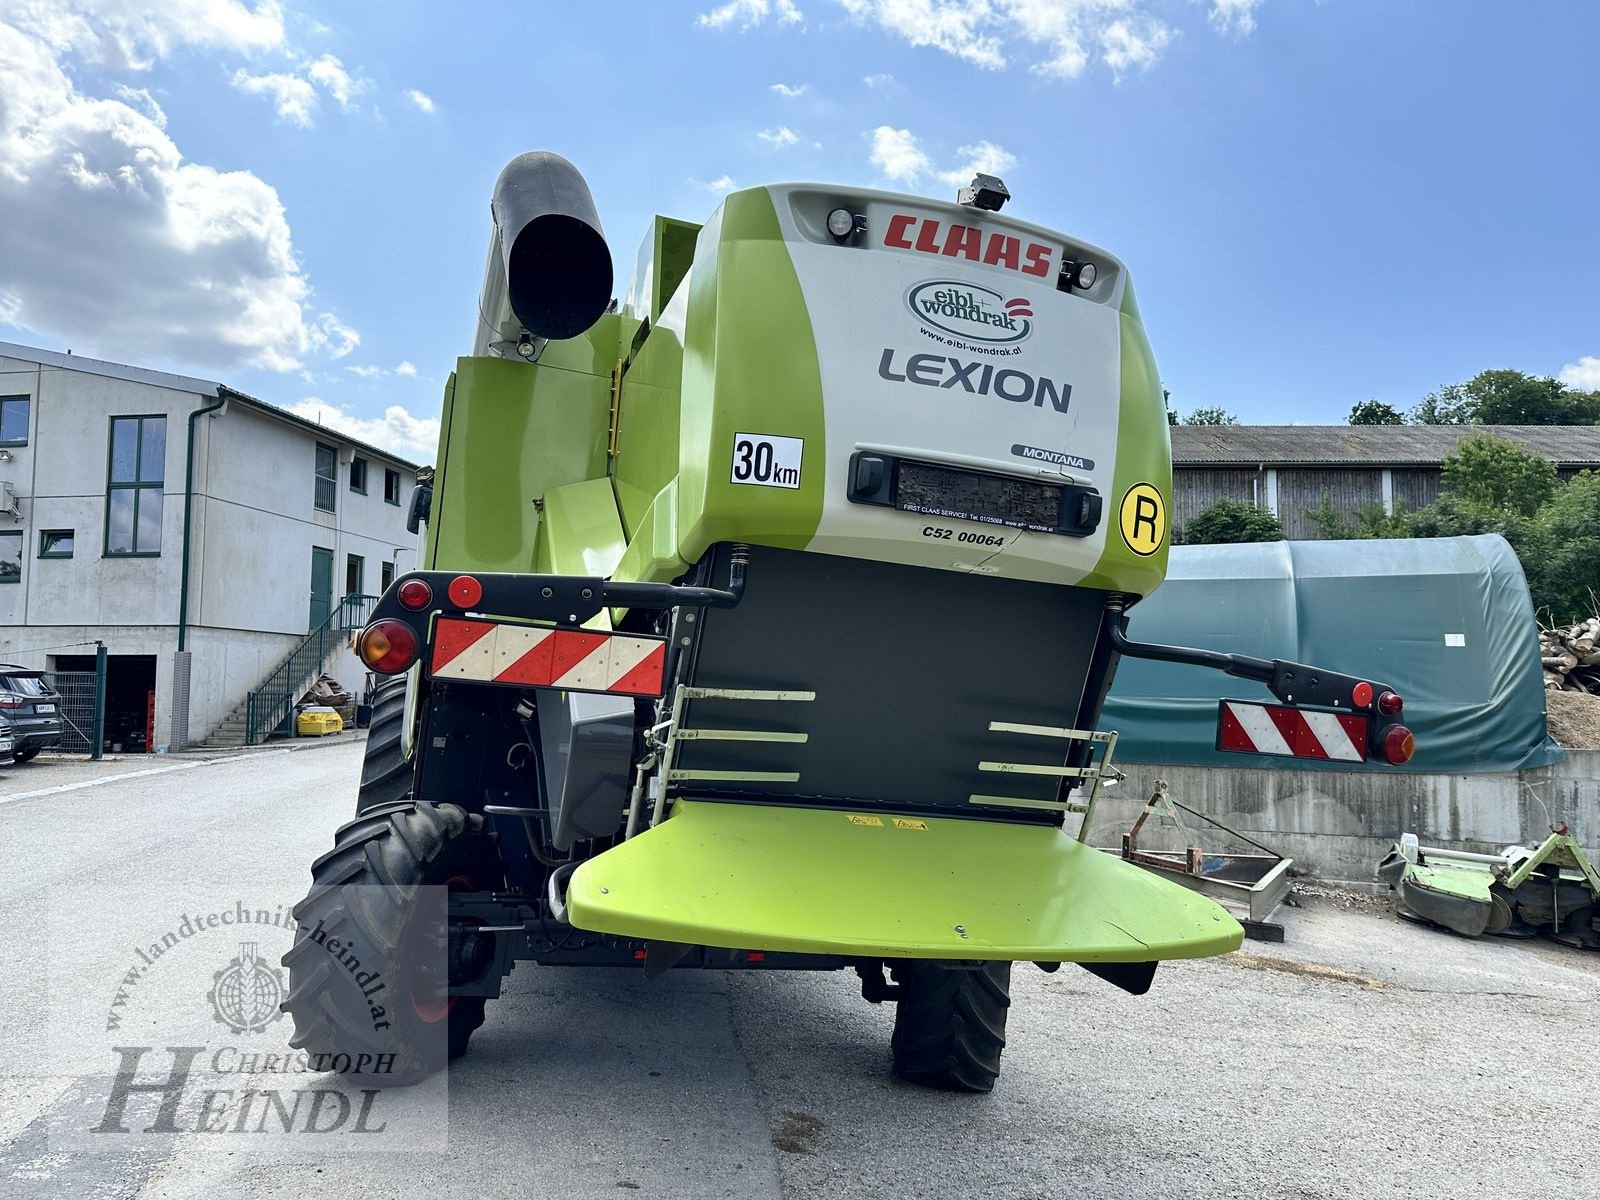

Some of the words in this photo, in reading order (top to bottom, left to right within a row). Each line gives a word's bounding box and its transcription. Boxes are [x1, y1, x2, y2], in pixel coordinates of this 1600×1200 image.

[883, 214, 1053, 278] CLAAS
[934, 288, 975, 309] eibl
[920, 299, 1018, 332] wondrak
[878, 348, 1073, 414] LEXION
[734, 440, 774, 482] 30
[773, 462, 798, 485] km
[1022, 447, 1085, 469] MONTANA
[903, 503, 920, 512] FIRST
[921, 506, 940, 515] CLAAS
[1132, 494, 1157, 544] R
[922, 526, 953, 540] C52
[957, 532, 1004, 547] 00064
